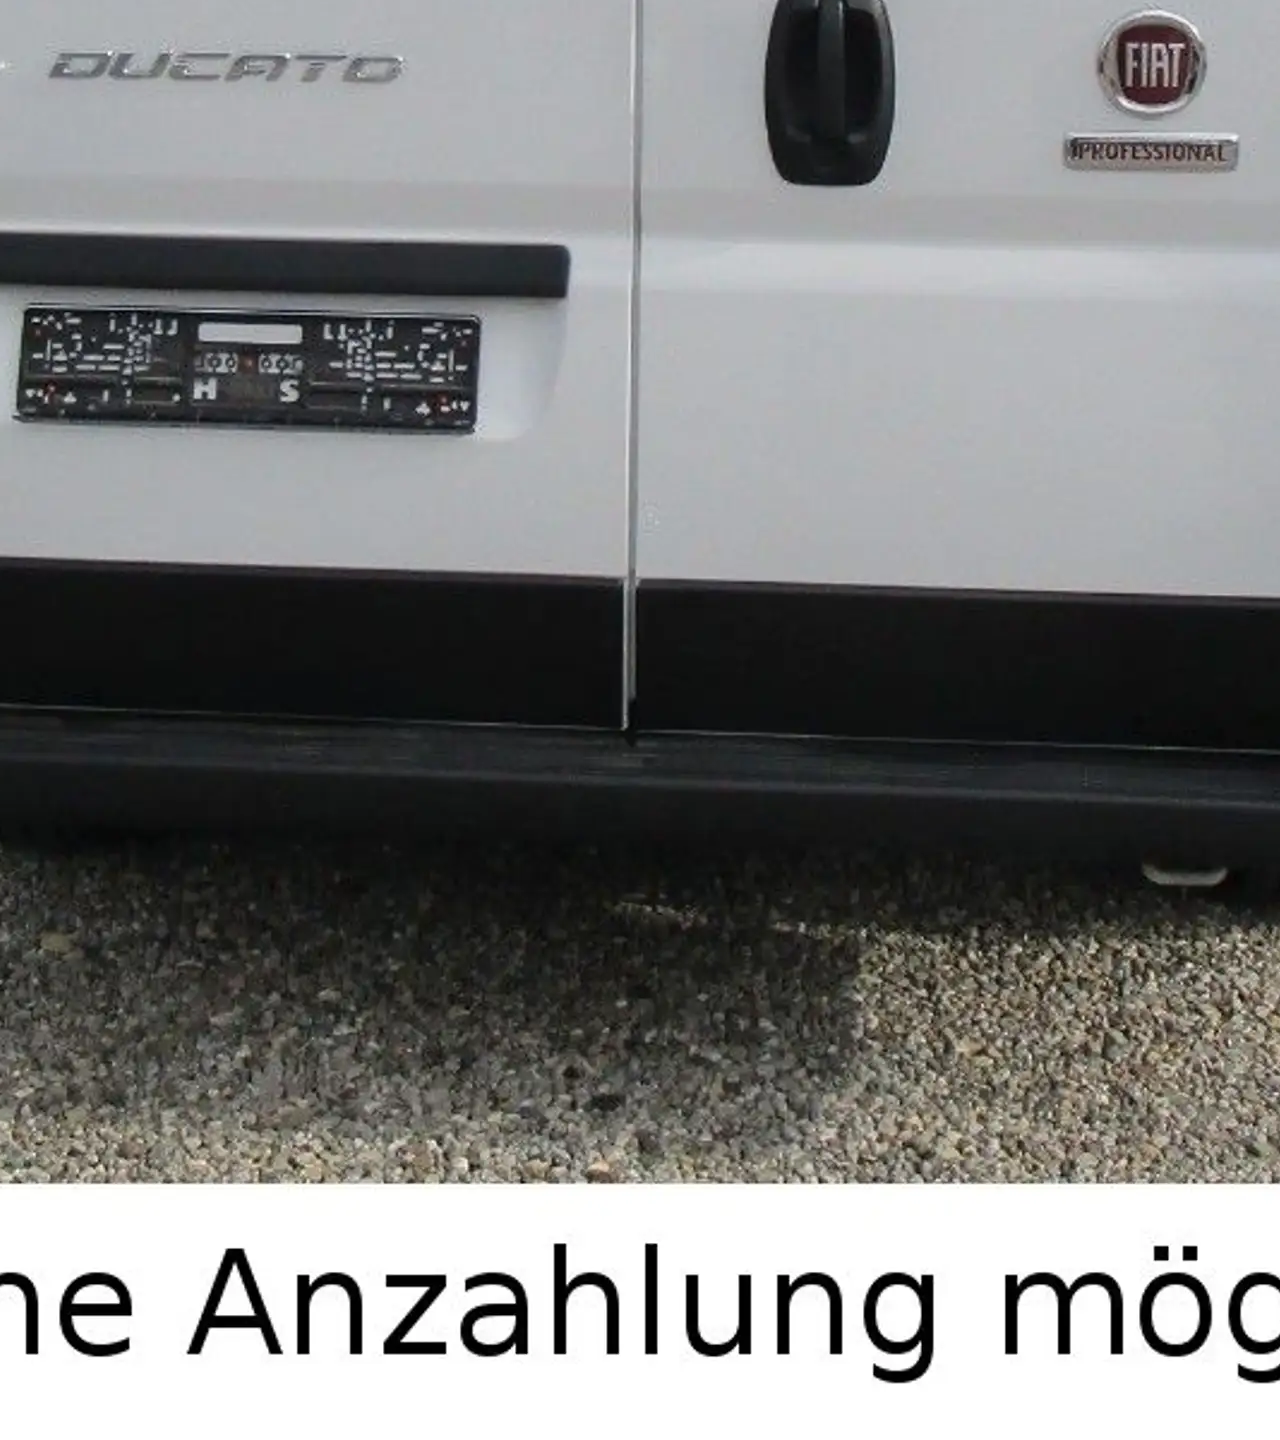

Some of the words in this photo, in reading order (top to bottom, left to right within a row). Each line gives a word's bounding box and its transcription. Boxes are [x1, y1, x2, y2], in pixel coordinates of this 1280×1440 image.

[48, 51, 406, 83] DUCATO
[1124, 42, 1185, 88] FIAT
[1077, 141, 1228, 162] PROFESSIONAL
